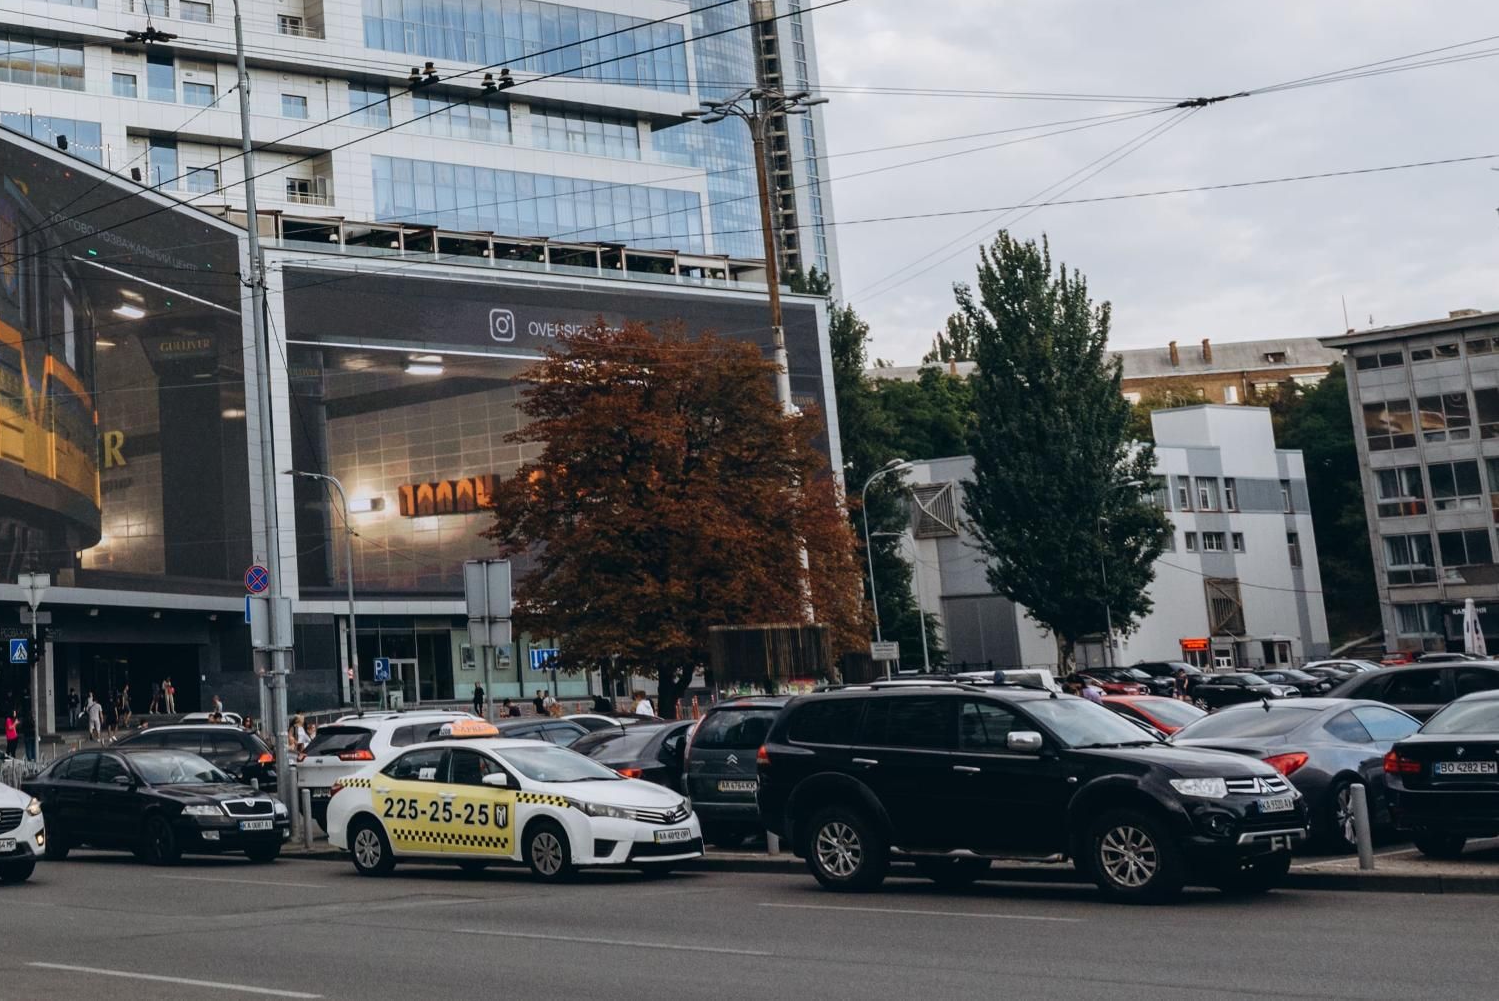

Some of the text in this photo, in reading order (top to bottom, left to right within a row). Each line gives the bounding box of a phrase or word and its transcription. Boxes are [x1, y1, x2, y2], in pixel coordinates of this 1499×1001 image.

[1441, 762, 1496, 773] BO 4282 EM
[384, 797, 489, 825] 225-25-25
